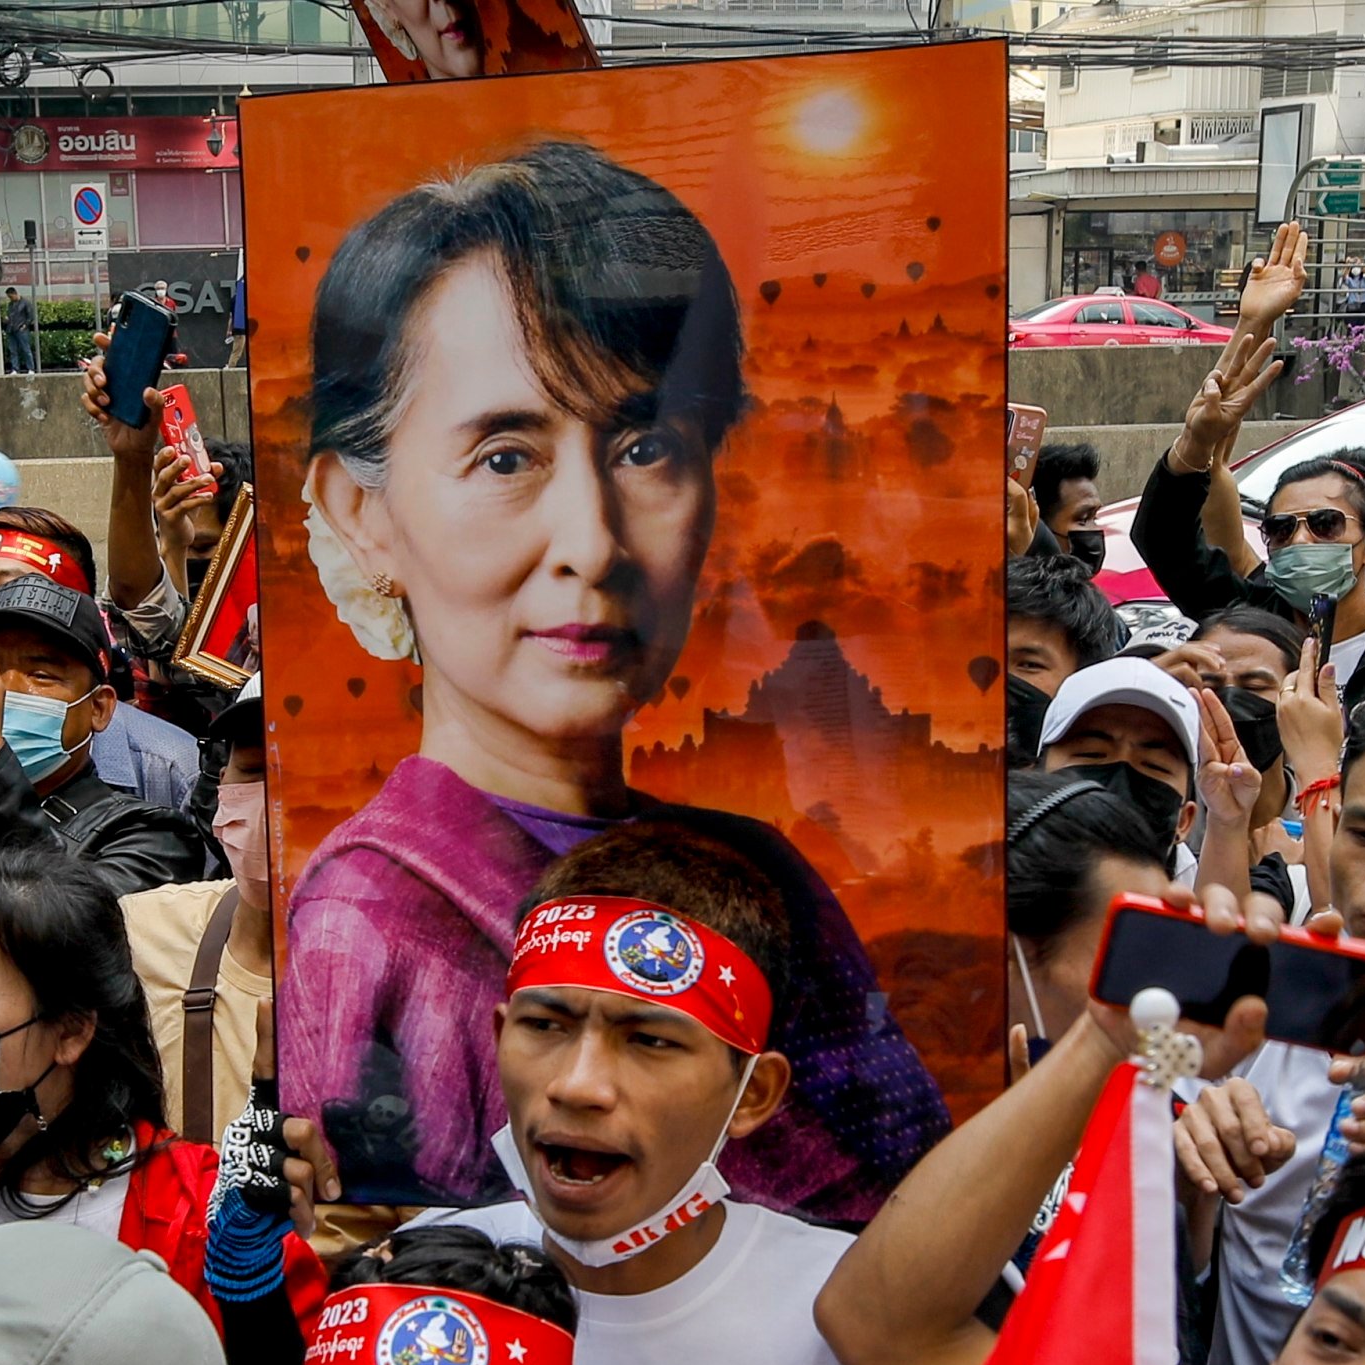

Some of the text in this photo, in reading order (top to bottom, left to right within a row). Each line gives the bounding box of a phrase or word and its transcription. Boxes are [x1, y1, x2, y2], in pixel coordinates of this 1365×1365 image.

[58, 129, 136, 152] ออมสิน
[532, 903, 597, 929] 2023
[318, 1296, 370, 1331] 2023
